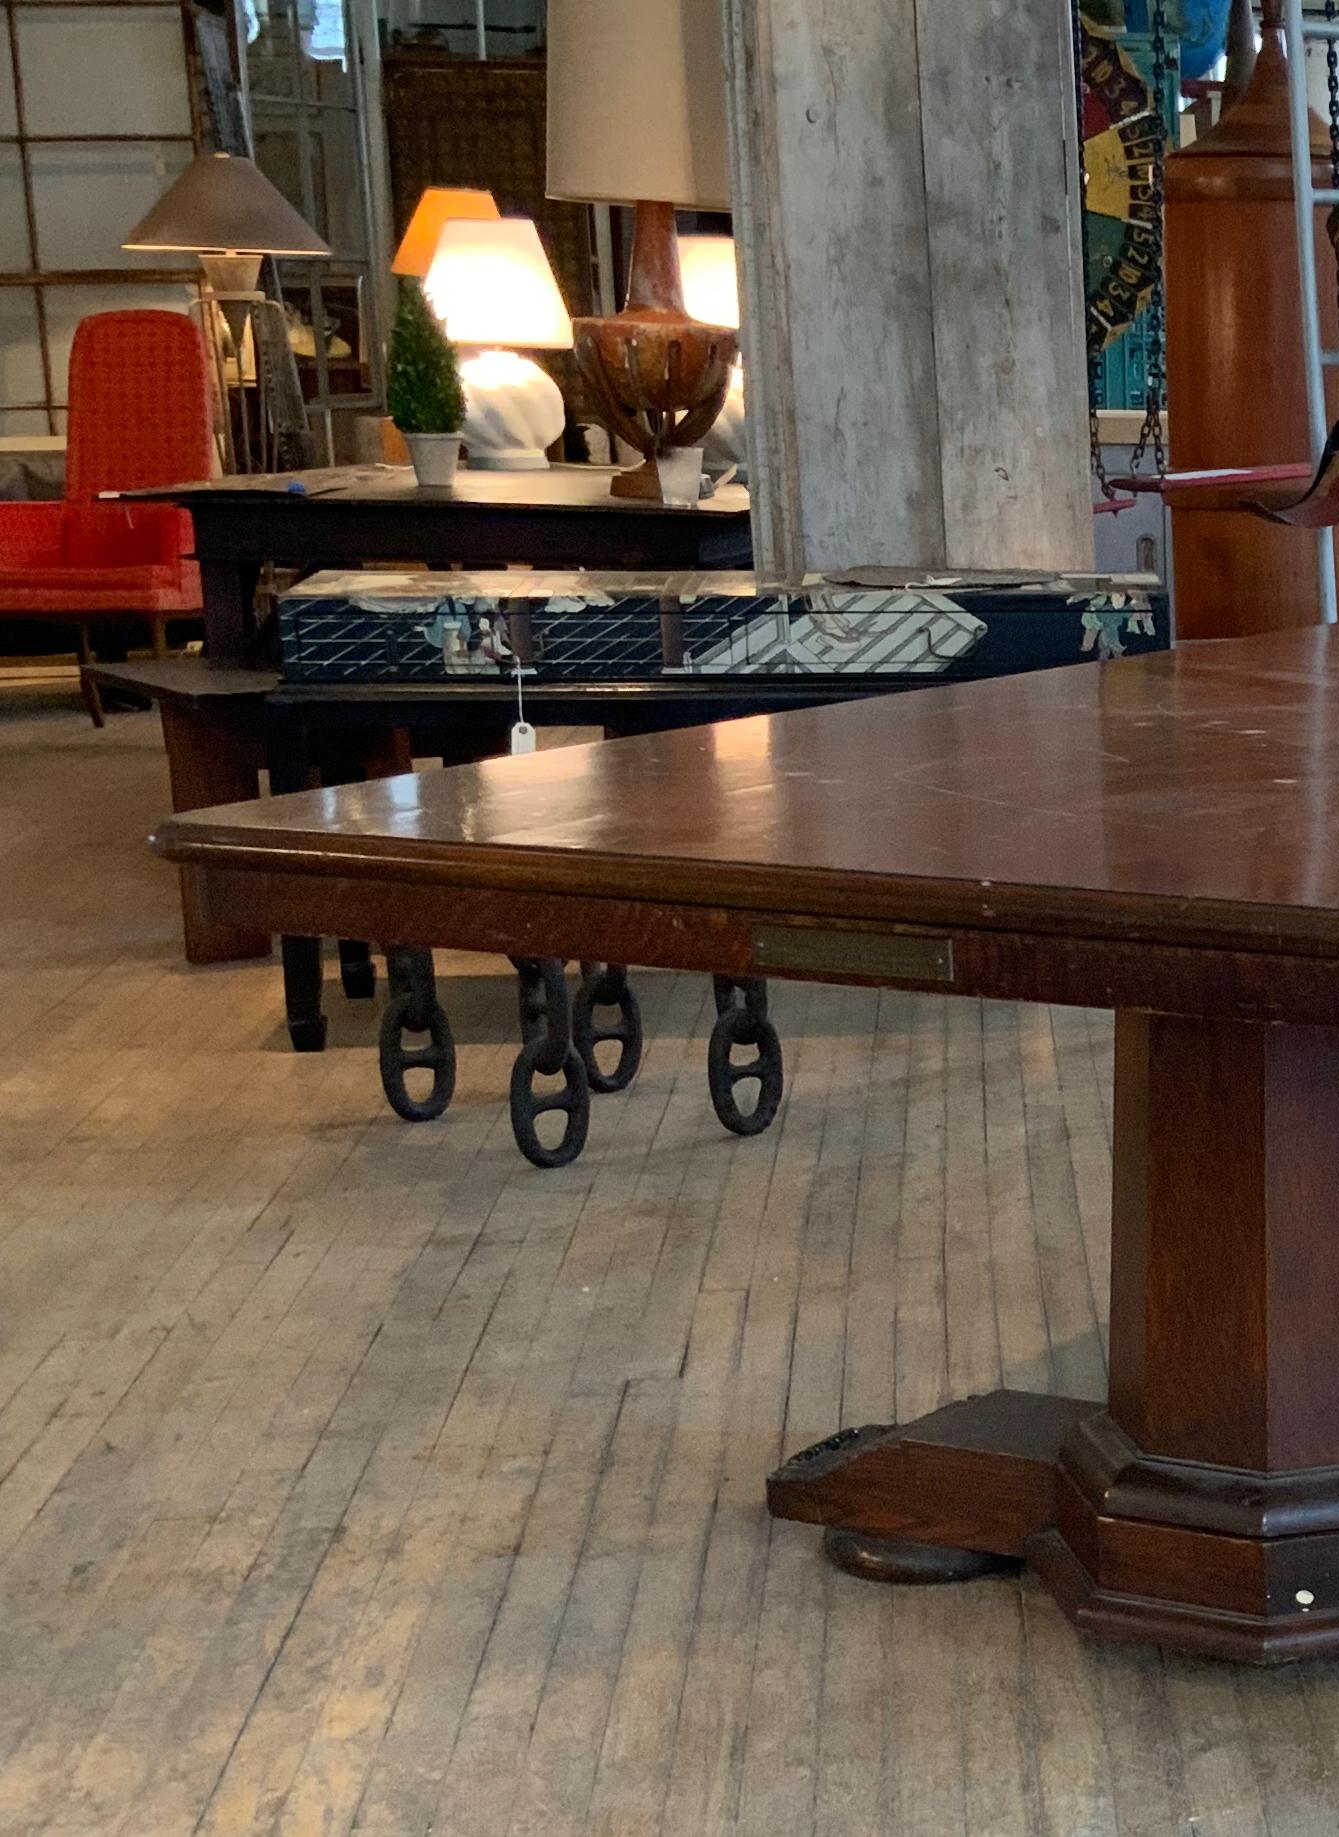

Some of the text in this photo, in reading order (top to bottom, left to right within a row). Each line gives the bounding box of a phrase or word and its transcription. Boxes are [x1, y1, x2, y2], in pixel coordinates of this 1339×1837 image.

[1128, 246, 1149, 265] 2
[1118, 263, 1142, 285] 10
[1108, 281, 1130, 301] 3
